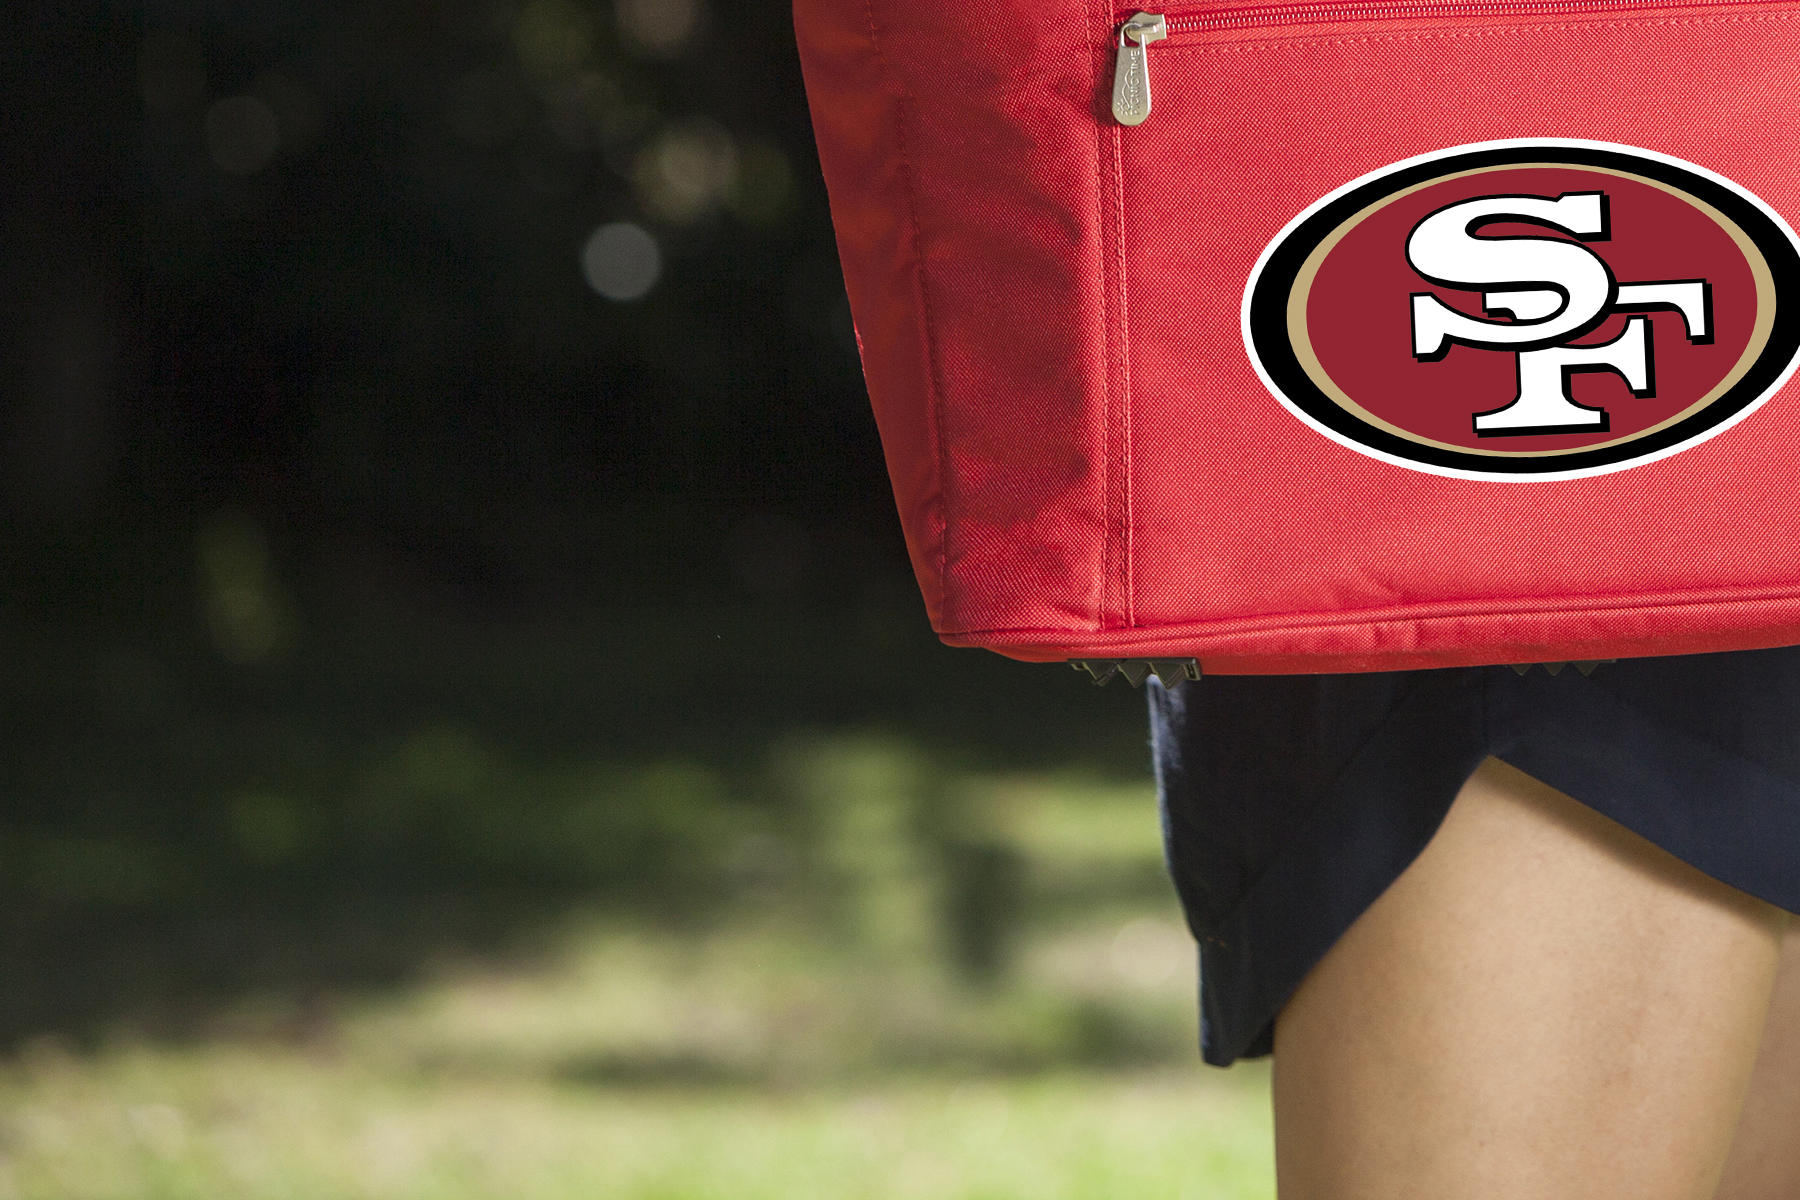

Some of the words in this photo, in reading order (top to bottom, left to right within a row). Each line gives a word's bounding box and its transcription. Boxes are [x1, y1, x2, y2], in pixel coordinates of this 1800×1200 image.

[1130, 50, 1140, 76] TIME
[1130, 78, 1140, 116] PICNIC
[1405, 190, 1714, 438] SF
